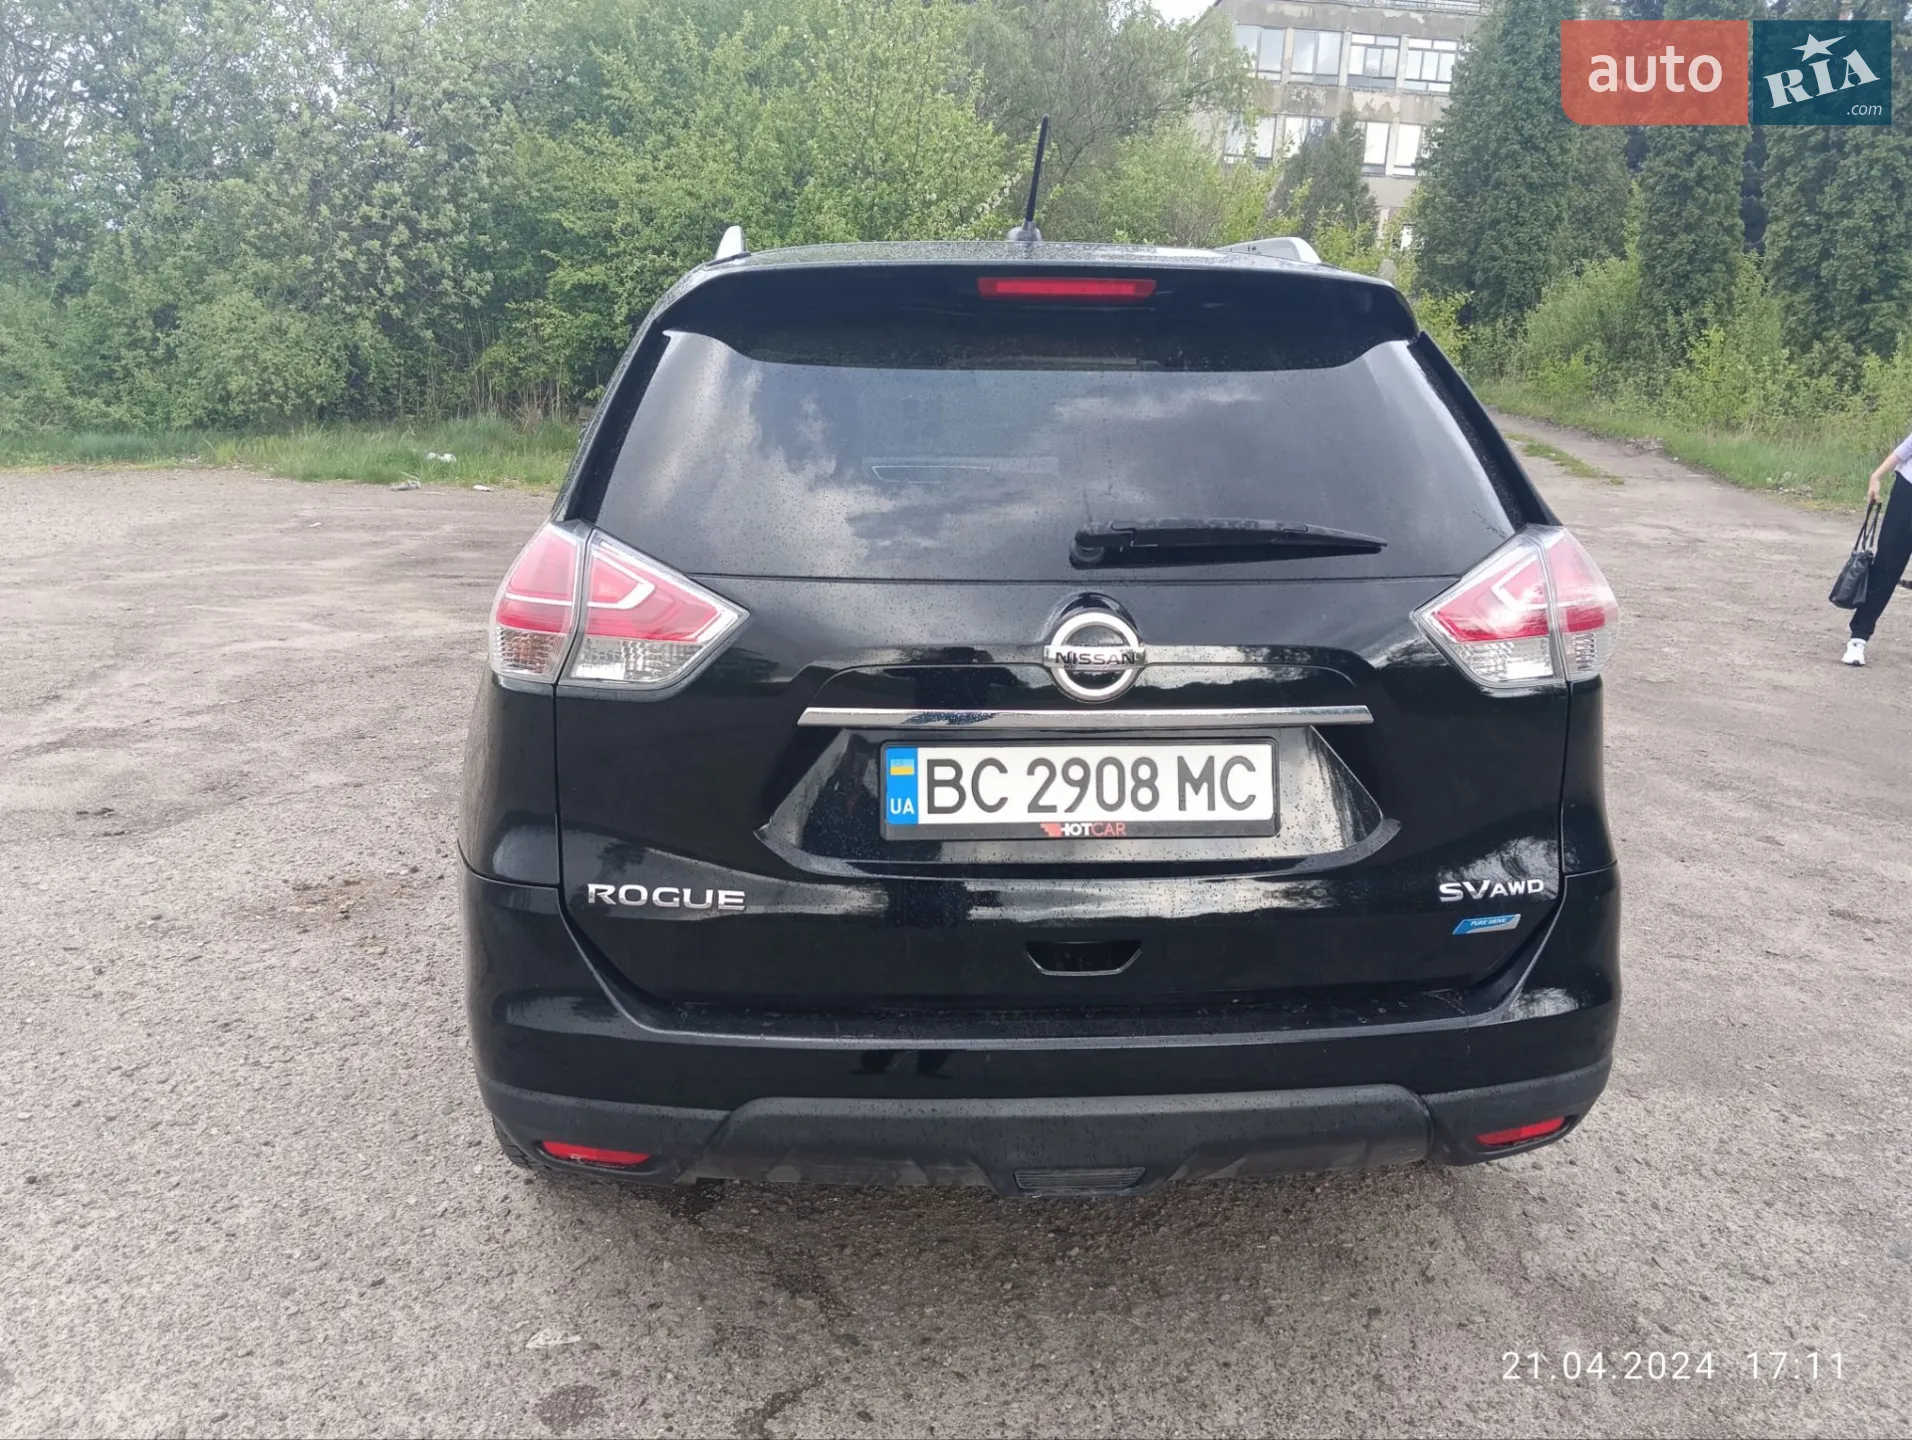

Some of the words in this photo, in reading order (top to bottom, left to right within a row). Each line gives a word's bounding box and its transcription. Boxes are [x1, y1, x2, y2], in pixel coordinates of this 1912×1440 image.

[1055, 651, 1136, 665] NISSAN
[926, 758, 1009, 814] BC
[1026, 756, 1160, 814] 2908
[1177, 755, 1257, 812] MC
[890, 797, 915, 815] UA
[587, 883, 746, 911] ROGUE
